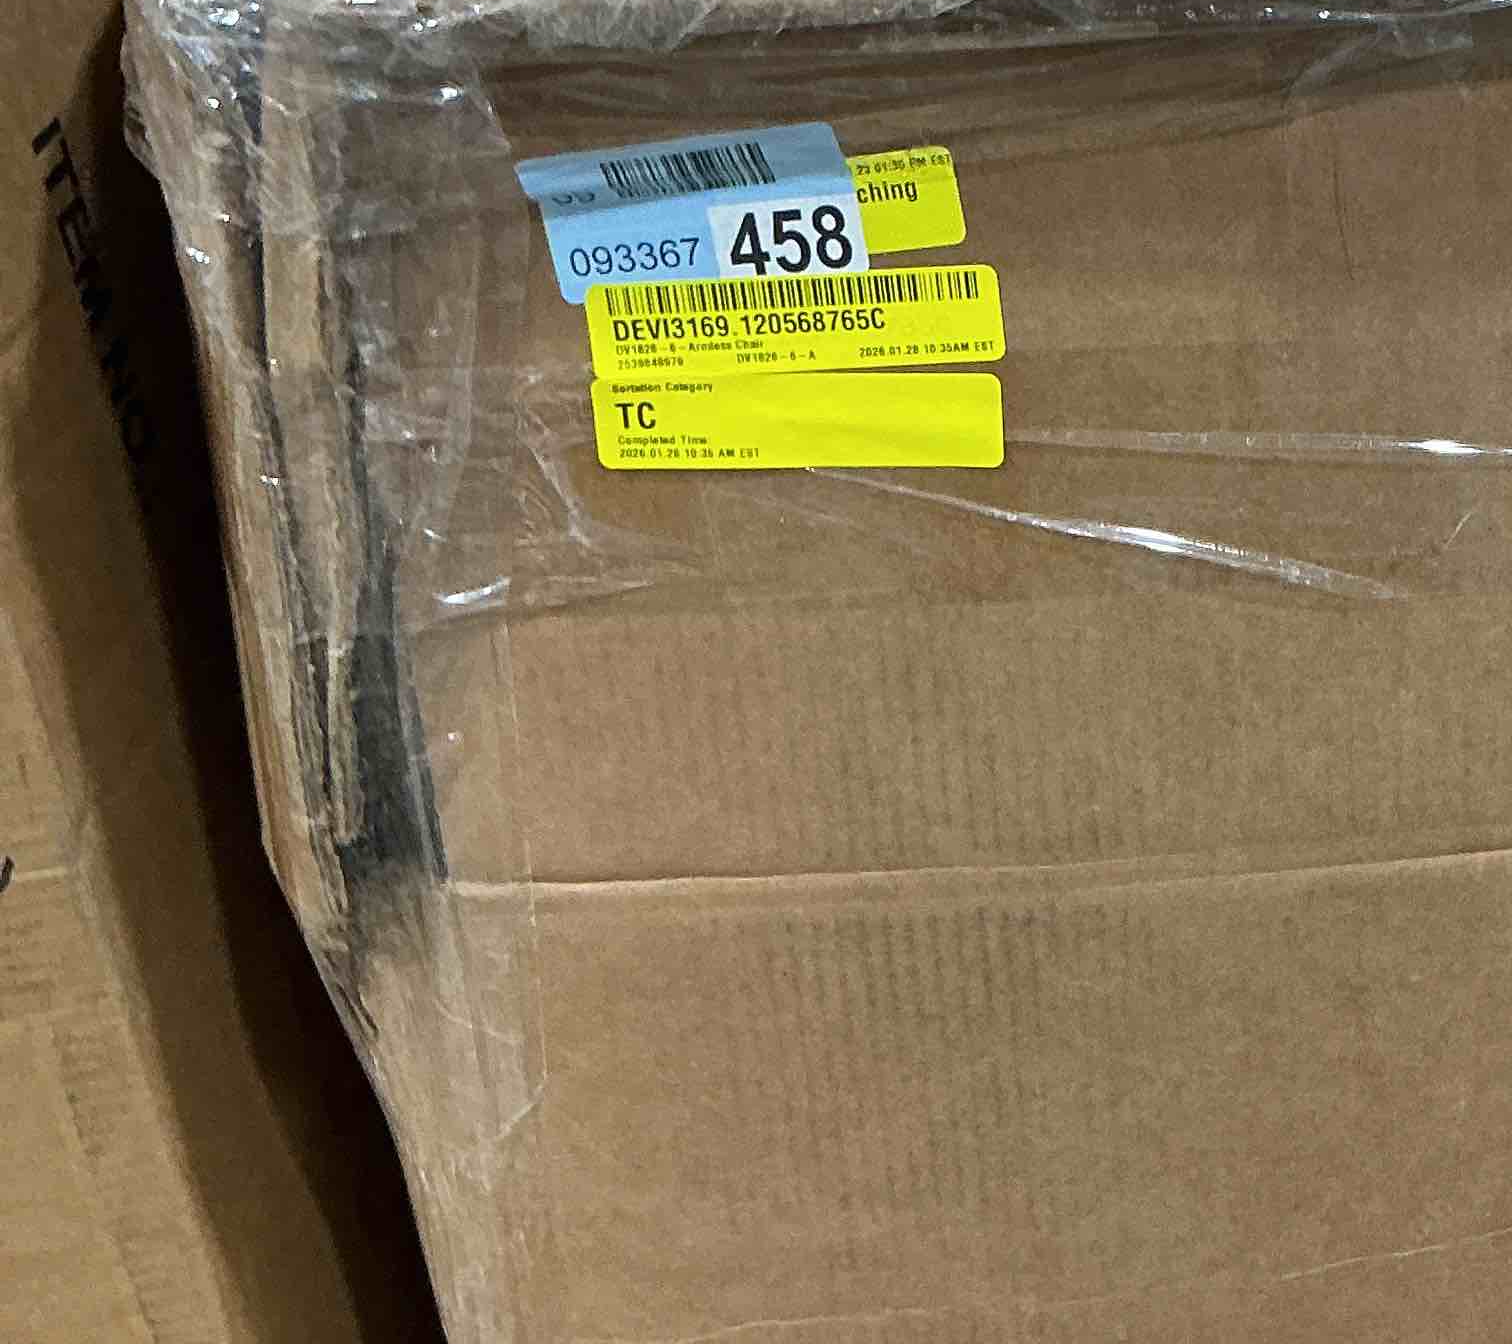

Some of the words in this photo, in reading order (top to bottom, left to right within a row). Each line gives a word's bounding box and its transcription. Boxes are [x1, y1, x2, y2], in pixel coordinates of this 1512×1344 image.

[730, 204, 853, 276] 458
[569, 237, 700, 277] 093367
[612, 307, 886, 341] DEVI3169.120568765C
[735, 339, 764, 349] Chair
[975, 340, 994, 351] EST
[611, 384, 661, 394] Sortation
[665, 382, 713, 393] Category
[614, 401, 657, 430] TC
[618, 435, 676, 447] Completed
[718, 447, 736, 457] AM
[739, 447, 759, 457] EST
